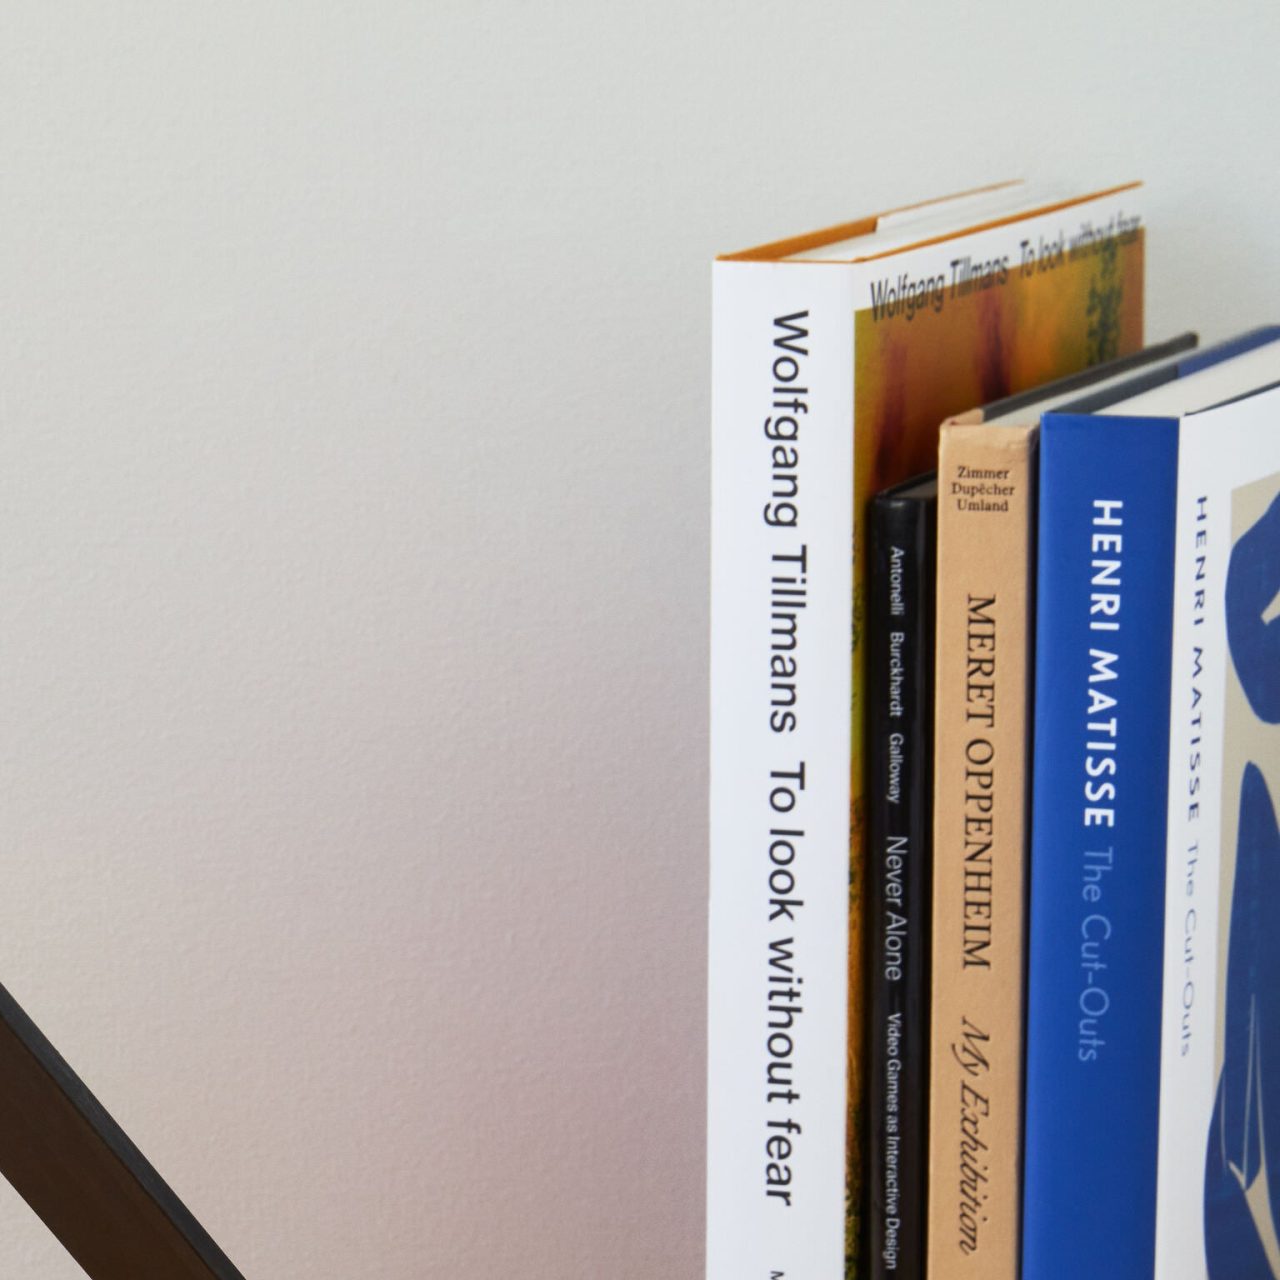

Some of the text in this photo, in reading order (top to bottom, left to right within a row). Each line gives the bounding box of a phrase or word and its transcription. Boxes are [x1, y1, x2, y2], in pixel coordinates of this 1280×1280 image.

[870, 211, 1141, 322] Wolfgang Tillmans To look without fear
[951, 482, 1015, 496] Dupêcher
[956, 498, 1009, 513] Umland
[957, 465, 1010, 480] Zimmer
[763, 310, 809, 1207] Wolfgang Tillmans To look without fear
[882, 546, 908, 1270] Antonelli Burckhardt Galloway Never Alone Video Games as Interactive Design
[951, 593, 996, 1256] MERET OPPENHEIM My Exhibition
[1078, 499, 1123, 1062] HENRI MATISSE The Cut-Outs
[1180, 496, 1208, 1058] HENRI MATISSE The Cut-Outs
